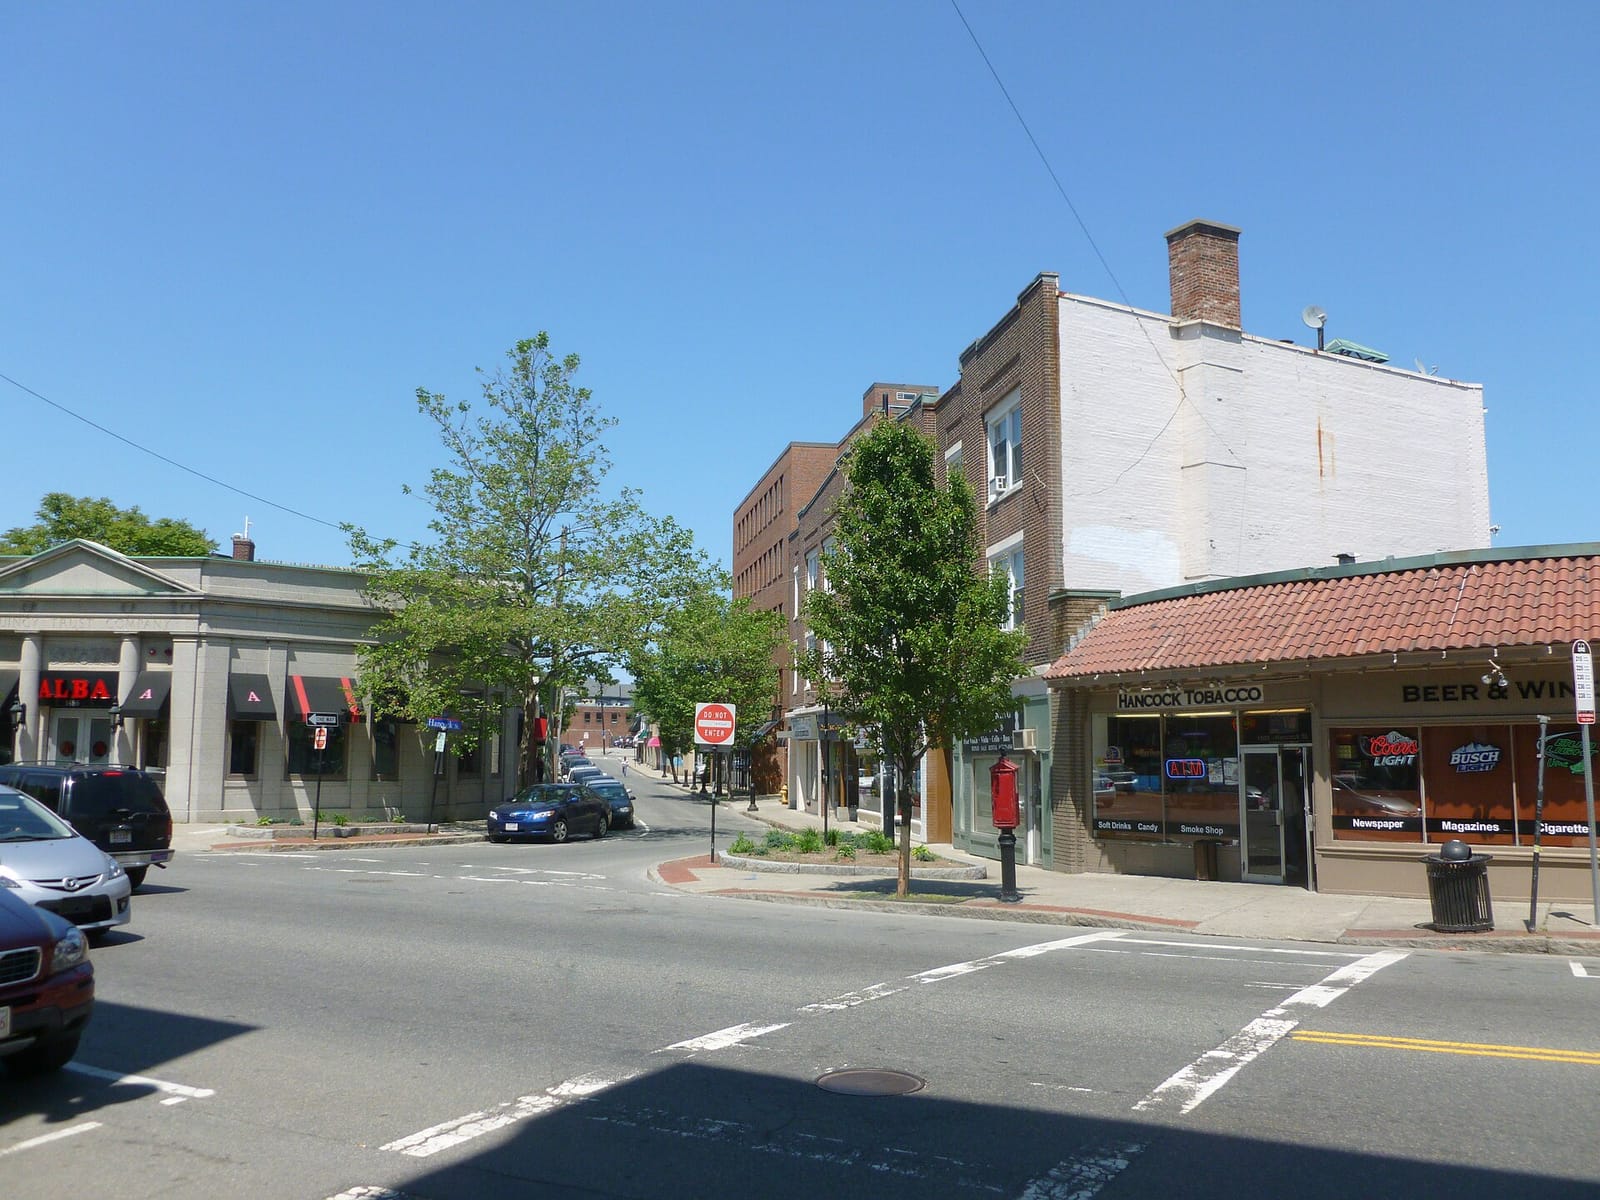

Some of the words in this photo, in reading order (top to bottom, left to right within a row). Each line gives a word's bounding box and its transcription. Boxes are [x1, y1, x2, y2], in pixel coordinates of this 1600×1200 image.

[39, 678, 111, 699] ALBA
[139, 688, 153, 699] A
[1402, 684, 1480, 702] BEER
[1488, 682, 1508, 699] &
[1515, 680, 1600, 699] WIN
[247, 691, 261, 702] A
[1119, 693, 1181, 708] HANCOCK
[1184, 687, 1261, 704] TOBACCO
[703, 711, 713, 719] DO
[714, 711, 727, 720] NOT
[704, 729, 725, 737] ENTER
[1370, 734, 1419, 757] Coors
[1373, 755, 1416, 767] LIGHT
[1450, 751, 1500, 765] BUSCH
[1170, 760, 1202, 776] ATM
[1098, 821, 1111, 829] Soft
[1111, 822, 1132, 830] Drinks
[1137, 823, 1158, 832] Candy
[1180, 824, 1204, 833] Smoke
[1205, 826, 1224, 835] Shop
[1352, 818, 1404, 830] Newspaper
[1441, 821, 1500, 832] Magazines
[1539, 822, 1590, 834] Cigarette
